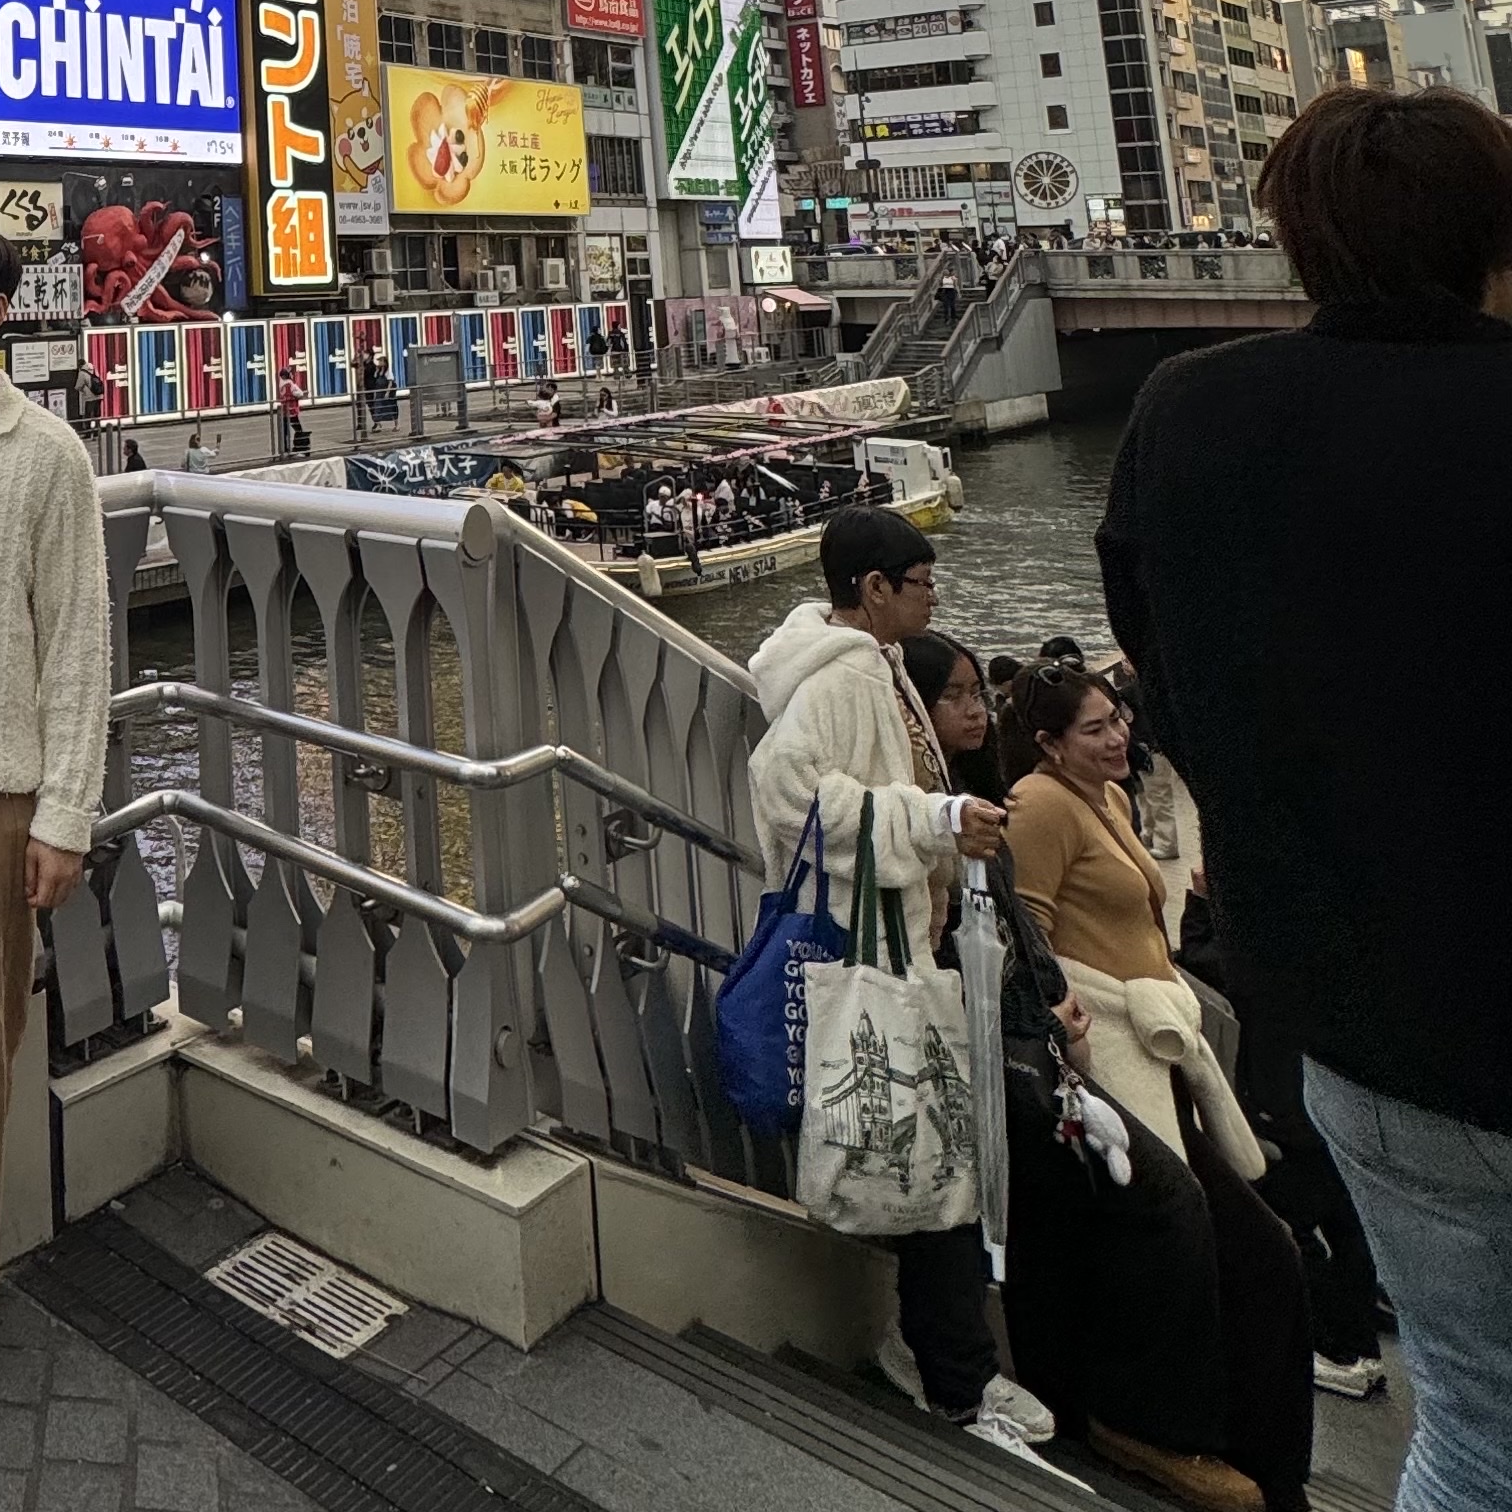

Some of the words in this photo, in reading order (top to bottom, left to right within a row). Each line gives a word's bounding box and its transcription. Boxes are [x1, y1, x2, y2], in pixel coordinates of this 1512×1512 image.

[796, 27, 817, 104] ネットカフェ
[497, 131, 541, 150] 大阪土産
[0, 189, 48, 231] くくる
[728, 564, 749, 584] NEW
[753, 556, 777, 576] STAR
